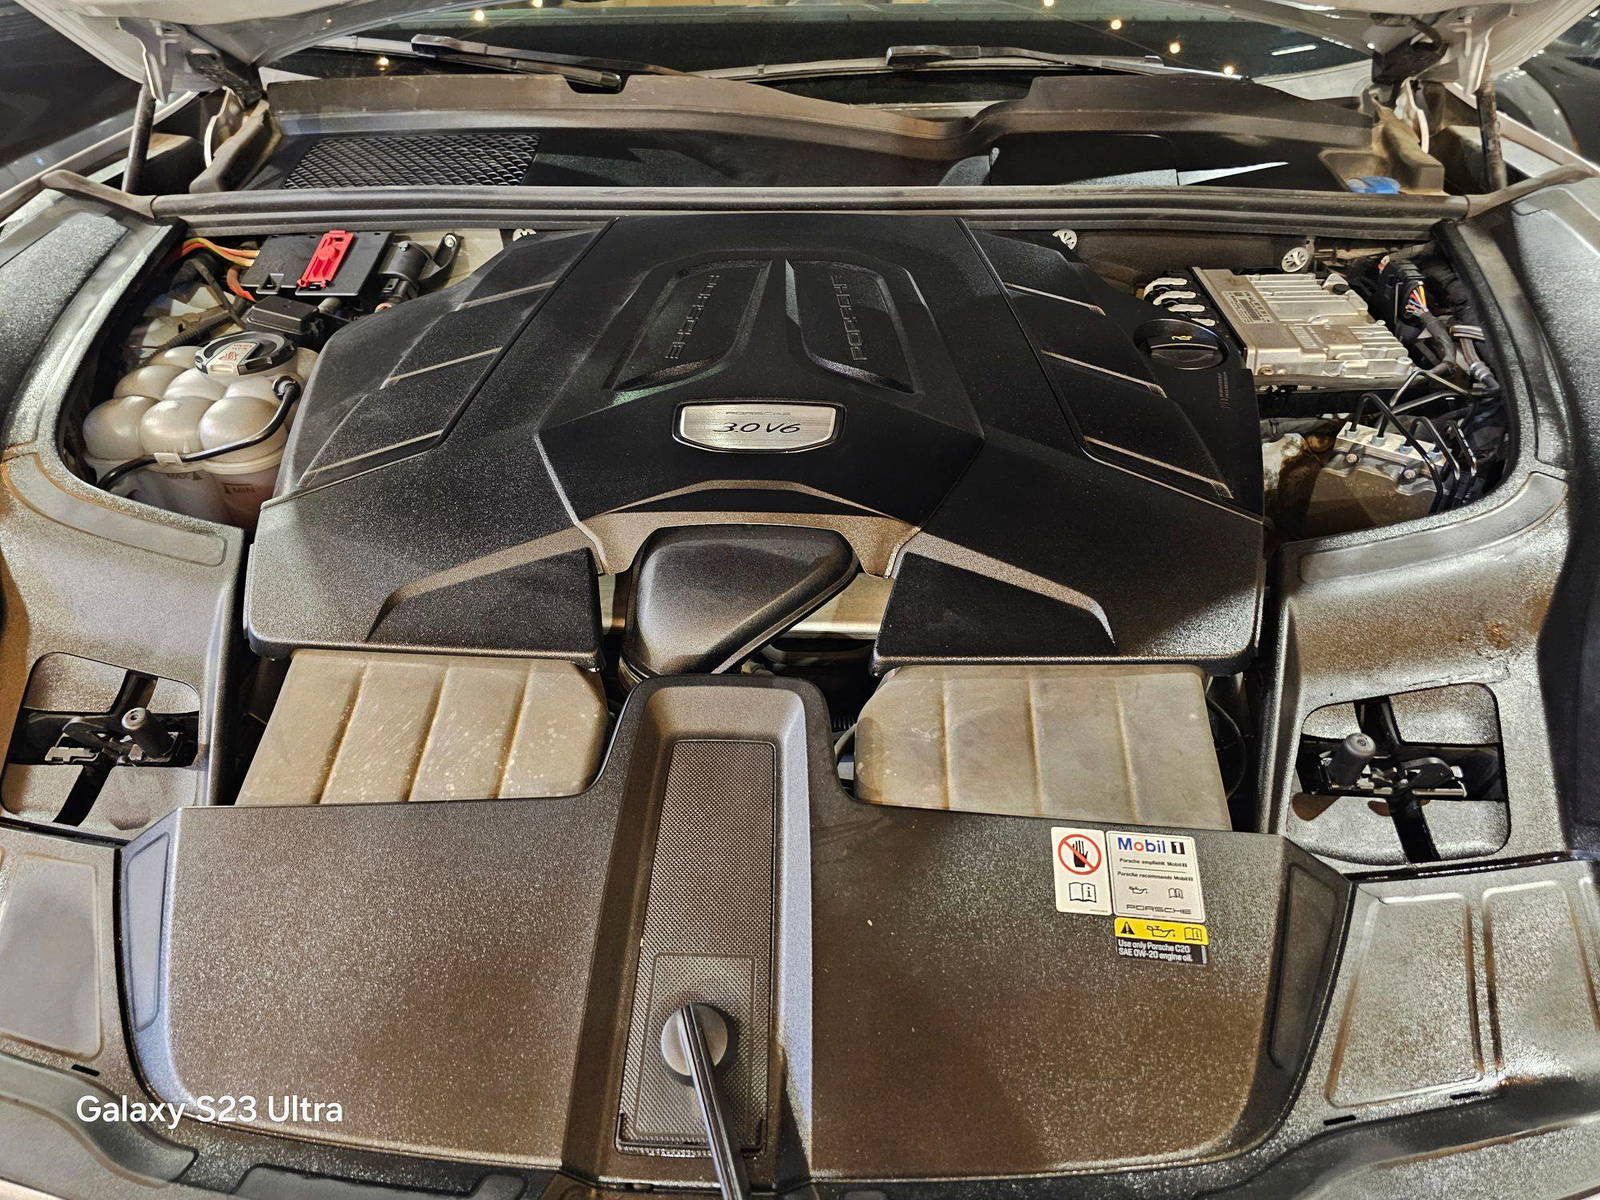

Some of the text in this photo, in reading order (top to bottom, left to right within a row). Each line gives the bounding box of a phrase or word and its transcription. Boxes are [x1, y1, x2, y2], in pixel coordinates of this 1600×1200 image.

[713, 422, 802, 434] 3.0 V6
[1117, 837, 1166, 854] Mobil
[1126, 904, 1191, 914] PORSCHE
[1118, 939, 1191, 953] Use only Porsche C20
[1118, 948, 1133, 956] SAE
[1133, 949, 1158, 958] 0W-20
[1159, 953, 1182, 961] engine
